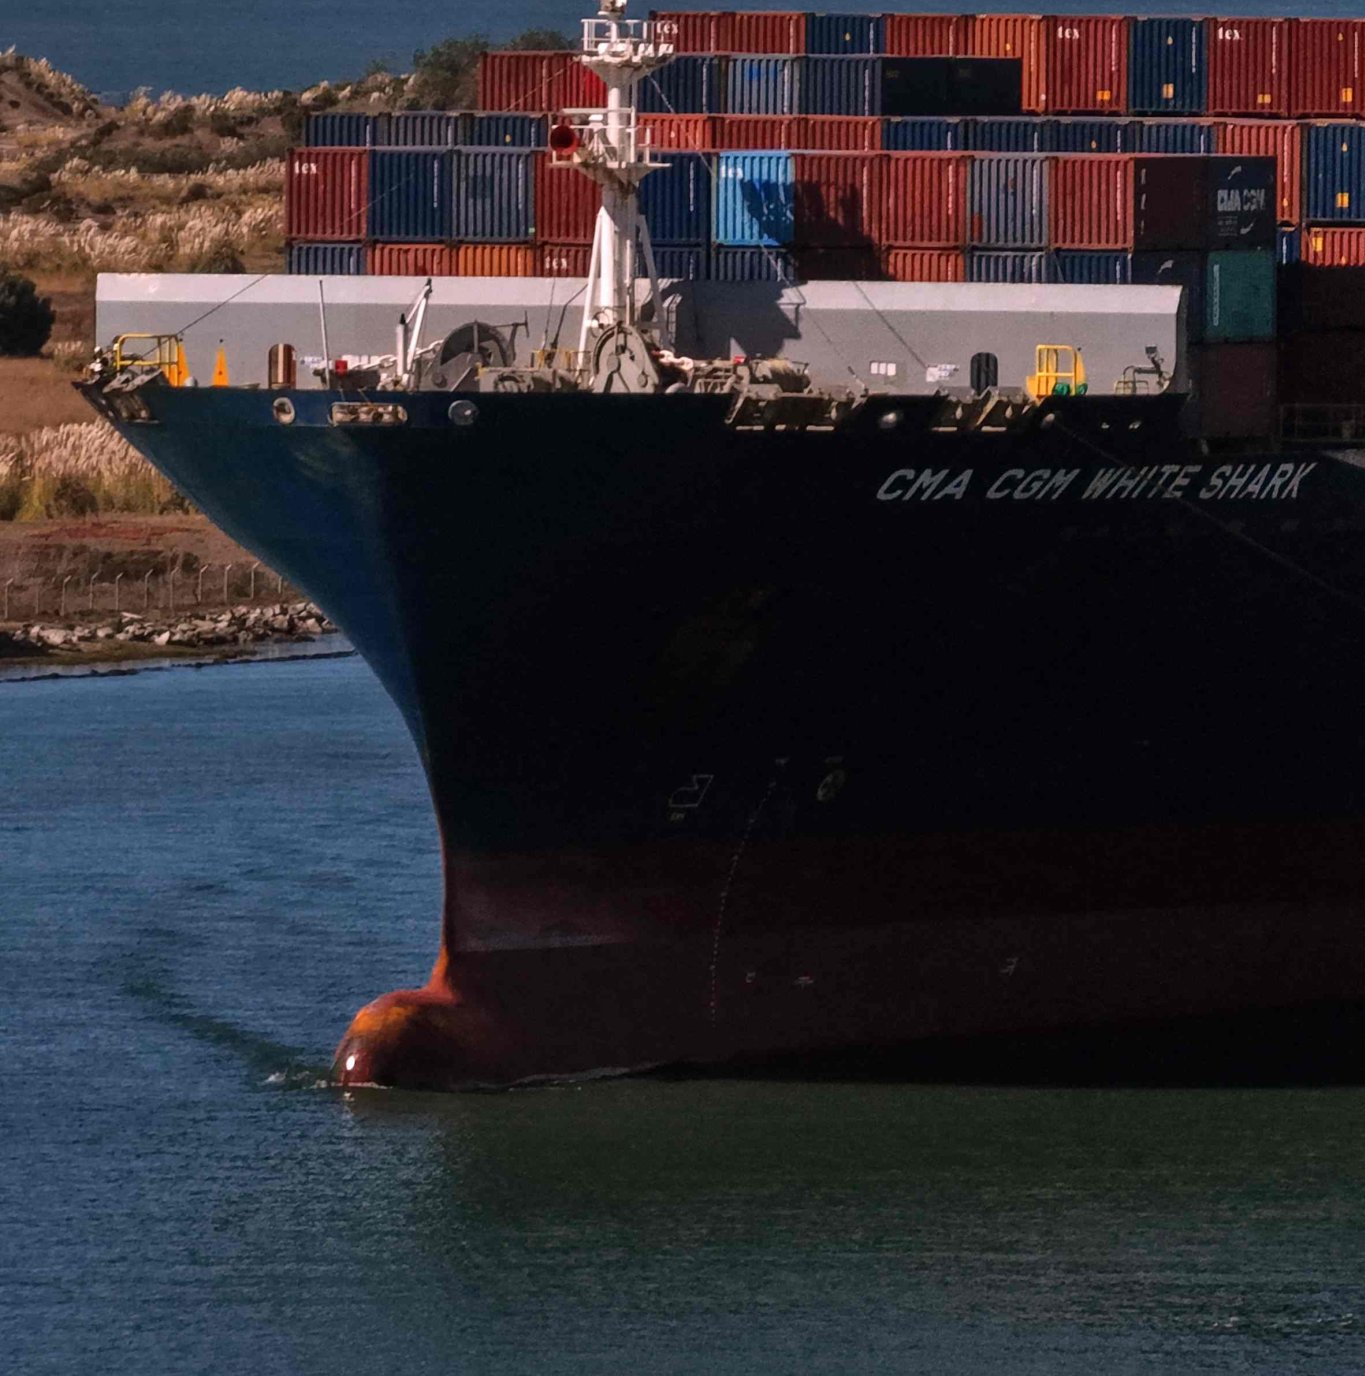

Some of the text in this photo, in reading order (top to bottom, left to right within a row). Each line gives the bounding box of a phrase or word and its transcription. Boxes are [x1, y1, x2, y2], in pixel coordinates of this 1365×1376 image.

[876, 462, 1317, 501] CMA CGM WHITE SHARK
